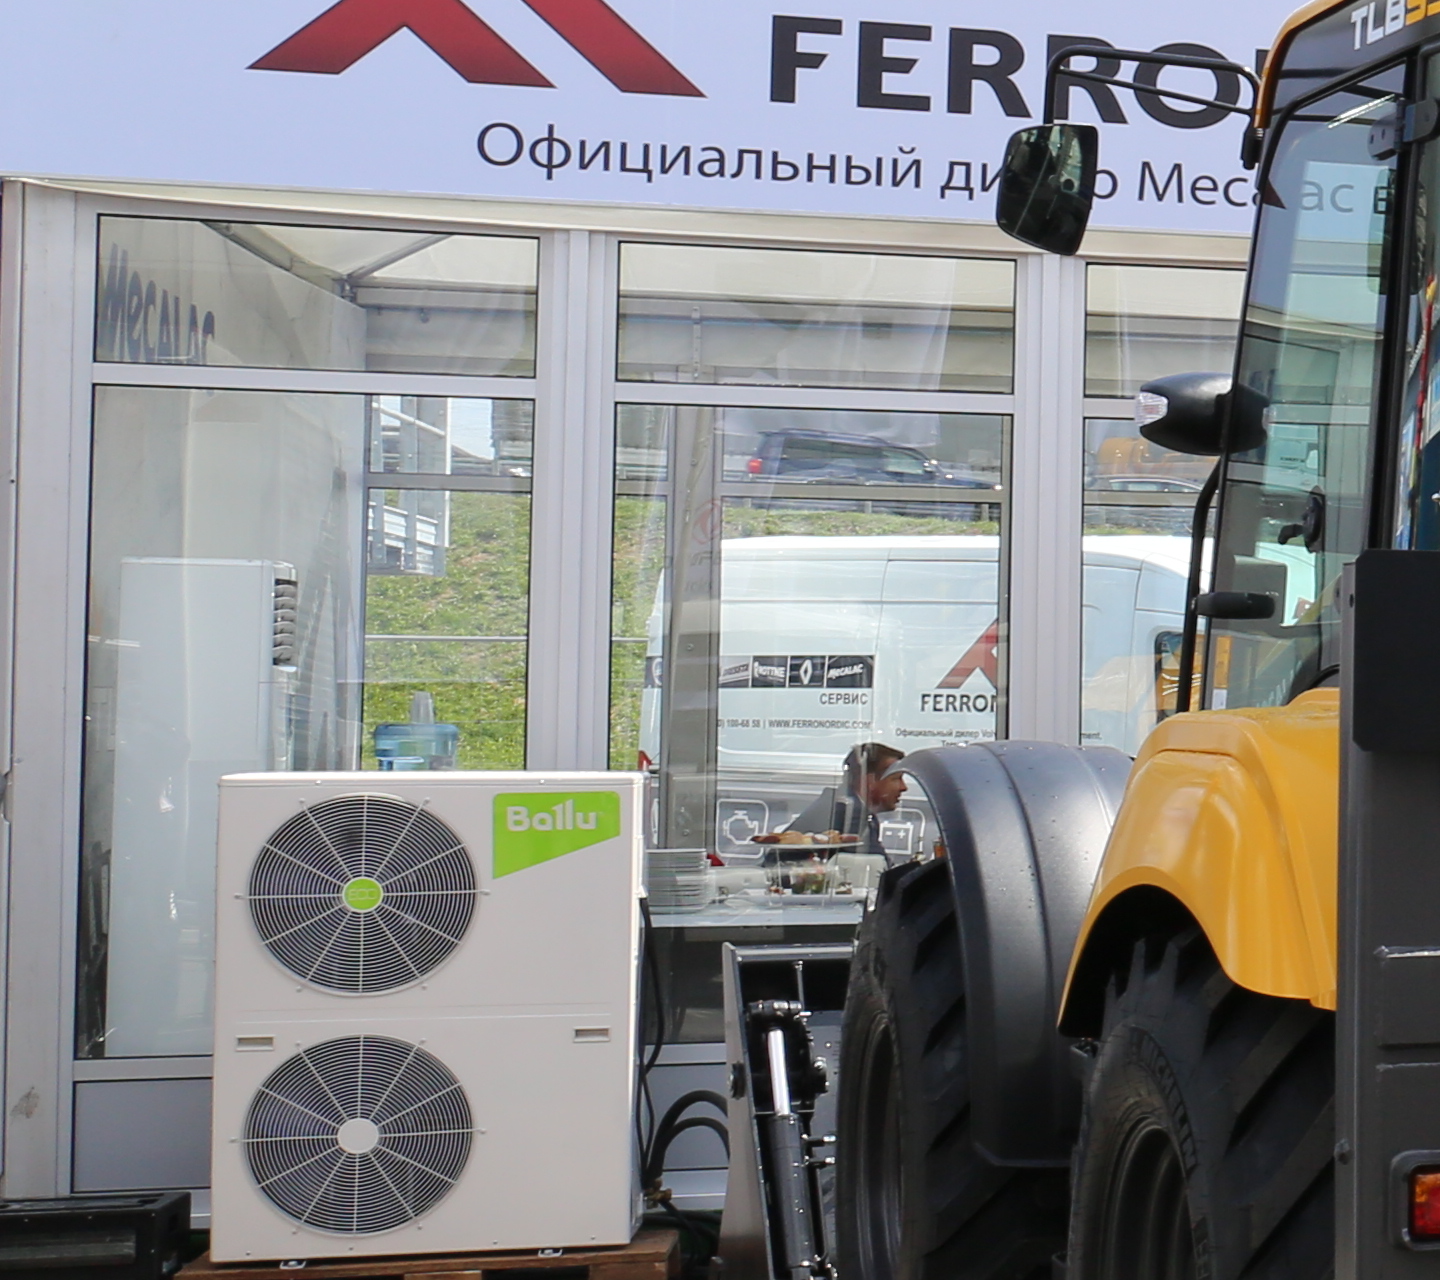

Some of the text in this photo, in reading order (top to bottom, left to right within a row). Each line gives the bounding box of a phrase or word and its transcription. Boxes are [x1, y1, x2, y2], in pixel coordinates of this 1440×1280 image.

[769, 14, 1264, 130] FERRO
[477, 122, 923, 181] Официальный
[940, 160, 1118, 205] дир
[1137, 160, 1354, 213] Mecac
[819, 692, 869, 706] СЕРВИС
[506, 799, 596, 832] Ballu
